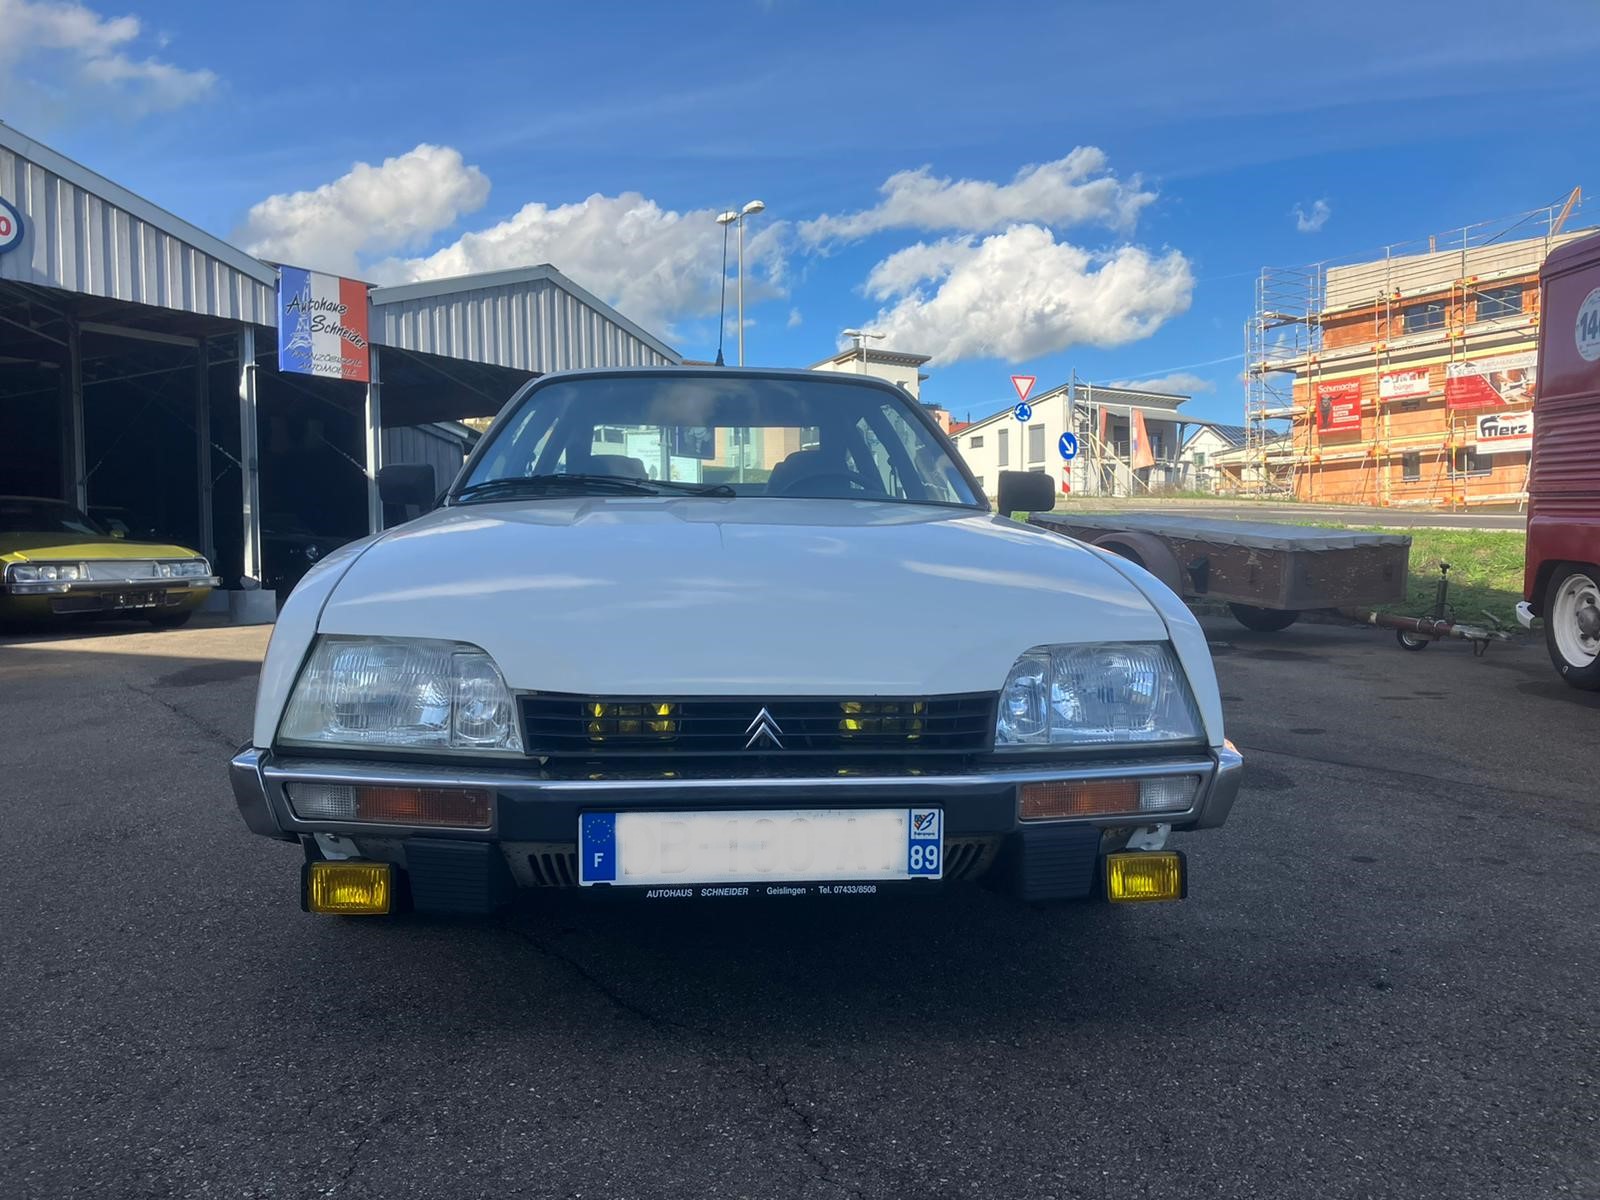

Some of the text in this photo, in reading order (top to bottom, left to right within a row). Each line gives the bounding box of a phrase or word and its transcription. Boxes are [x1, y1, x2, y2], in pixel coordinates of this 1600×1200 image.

[286, 294, 347, 314] Autohaus
[310, 315, 368, 349] Schneider
[1580, 309, 1600, 341] 14
[594, 852, 604, 868] F
[910, 844, 938, 870] 89
[646, 888, 693, 898] AUTOHAUS
[701, 887, 749, 897] SCHNEIDER
[766, 886, 806, 896] Geislingen
[818, 885, 832, 894] Tel.
